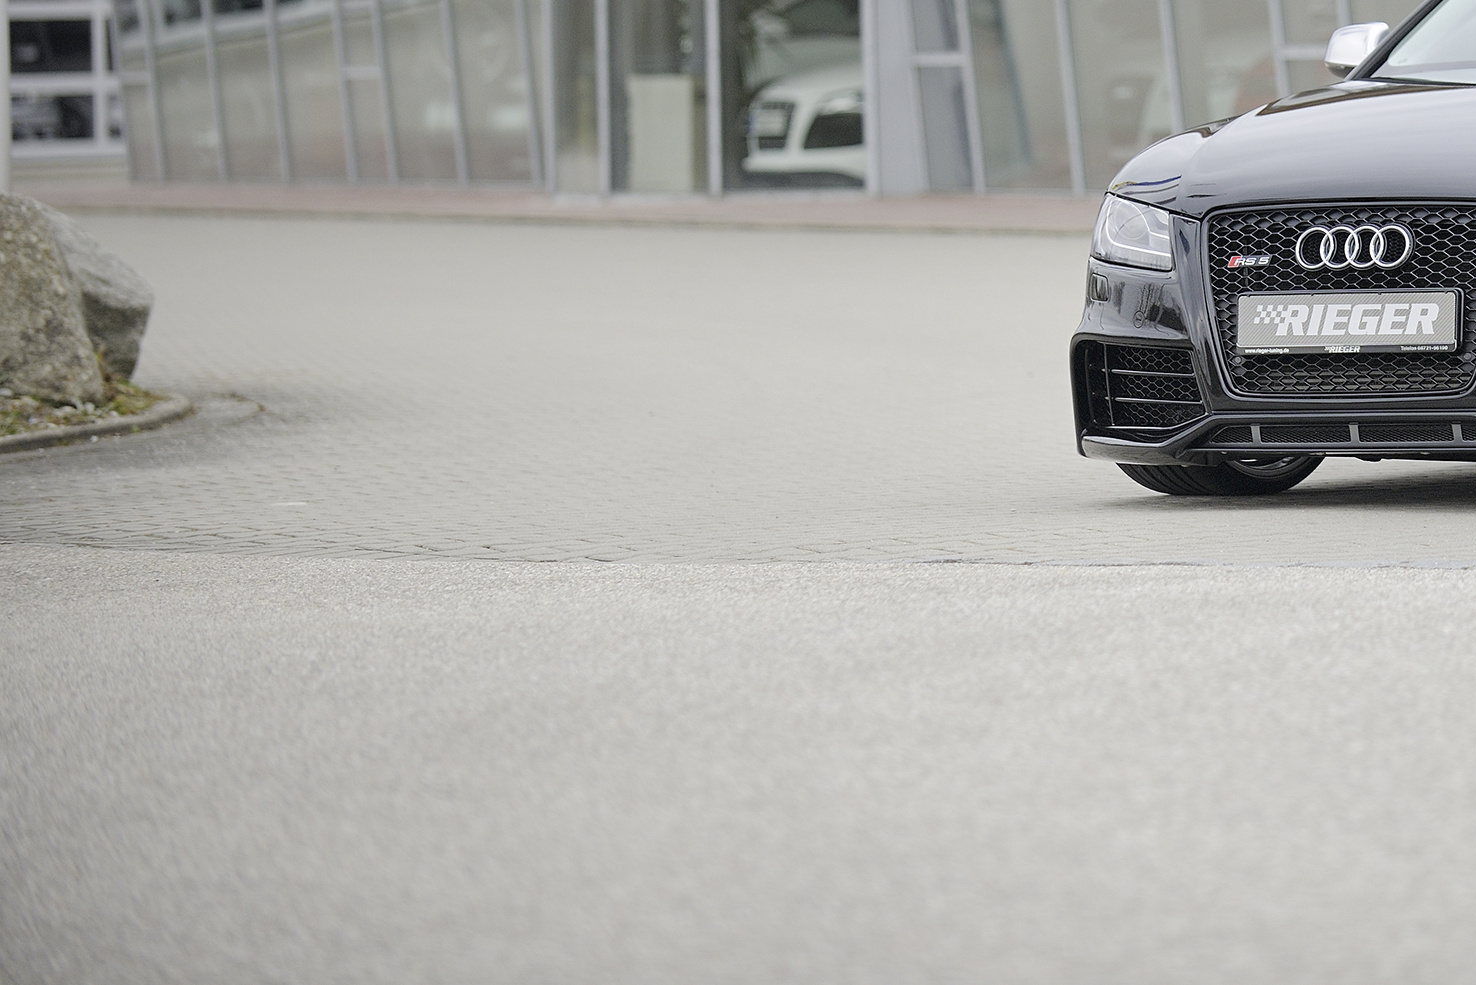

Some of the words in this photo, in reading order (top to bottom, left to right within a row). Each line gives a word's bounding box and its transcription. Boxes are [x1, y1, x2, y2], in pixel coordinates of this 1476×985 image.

[1233, 257, 1257, 266] RS
[1258, 256, 1270, 265] 5
[1276, 303, 1440, 336] RIEGER
[1328, 345, 1361, 353] RIEGER
